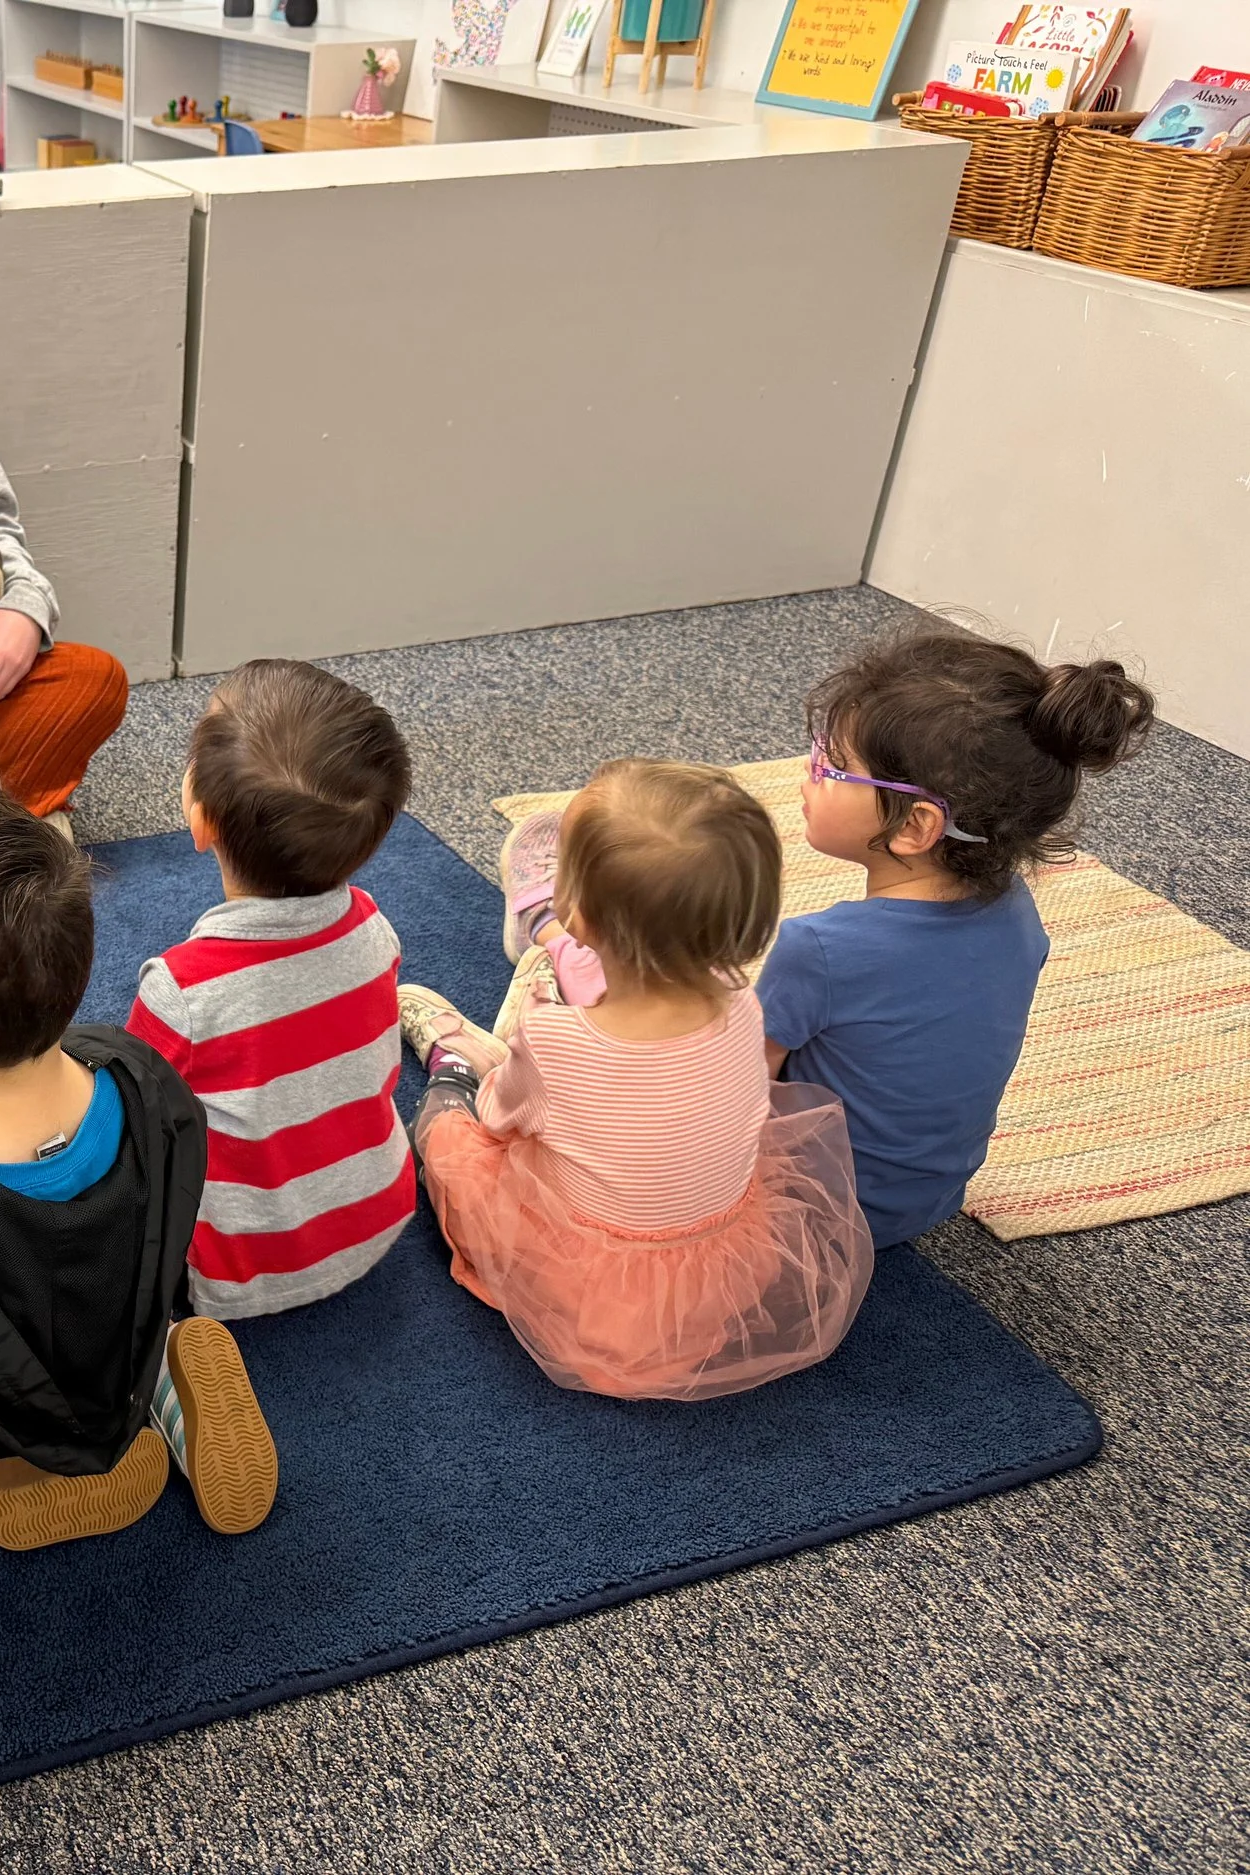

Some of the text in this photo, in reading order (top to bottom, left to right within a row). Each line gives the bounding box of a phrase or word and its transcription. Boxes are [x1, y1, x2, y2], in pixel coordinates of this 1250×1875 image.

[1046, 27, 1075, 42] Little
[966, 51, 995, 65] Picture
[994, 49, 1022, 68] Touch
[1030, 59, 1048, 71] Feel
[973, 67, 1033, 95] FARM
[1192, 90, 1238, 106] Aladdin
